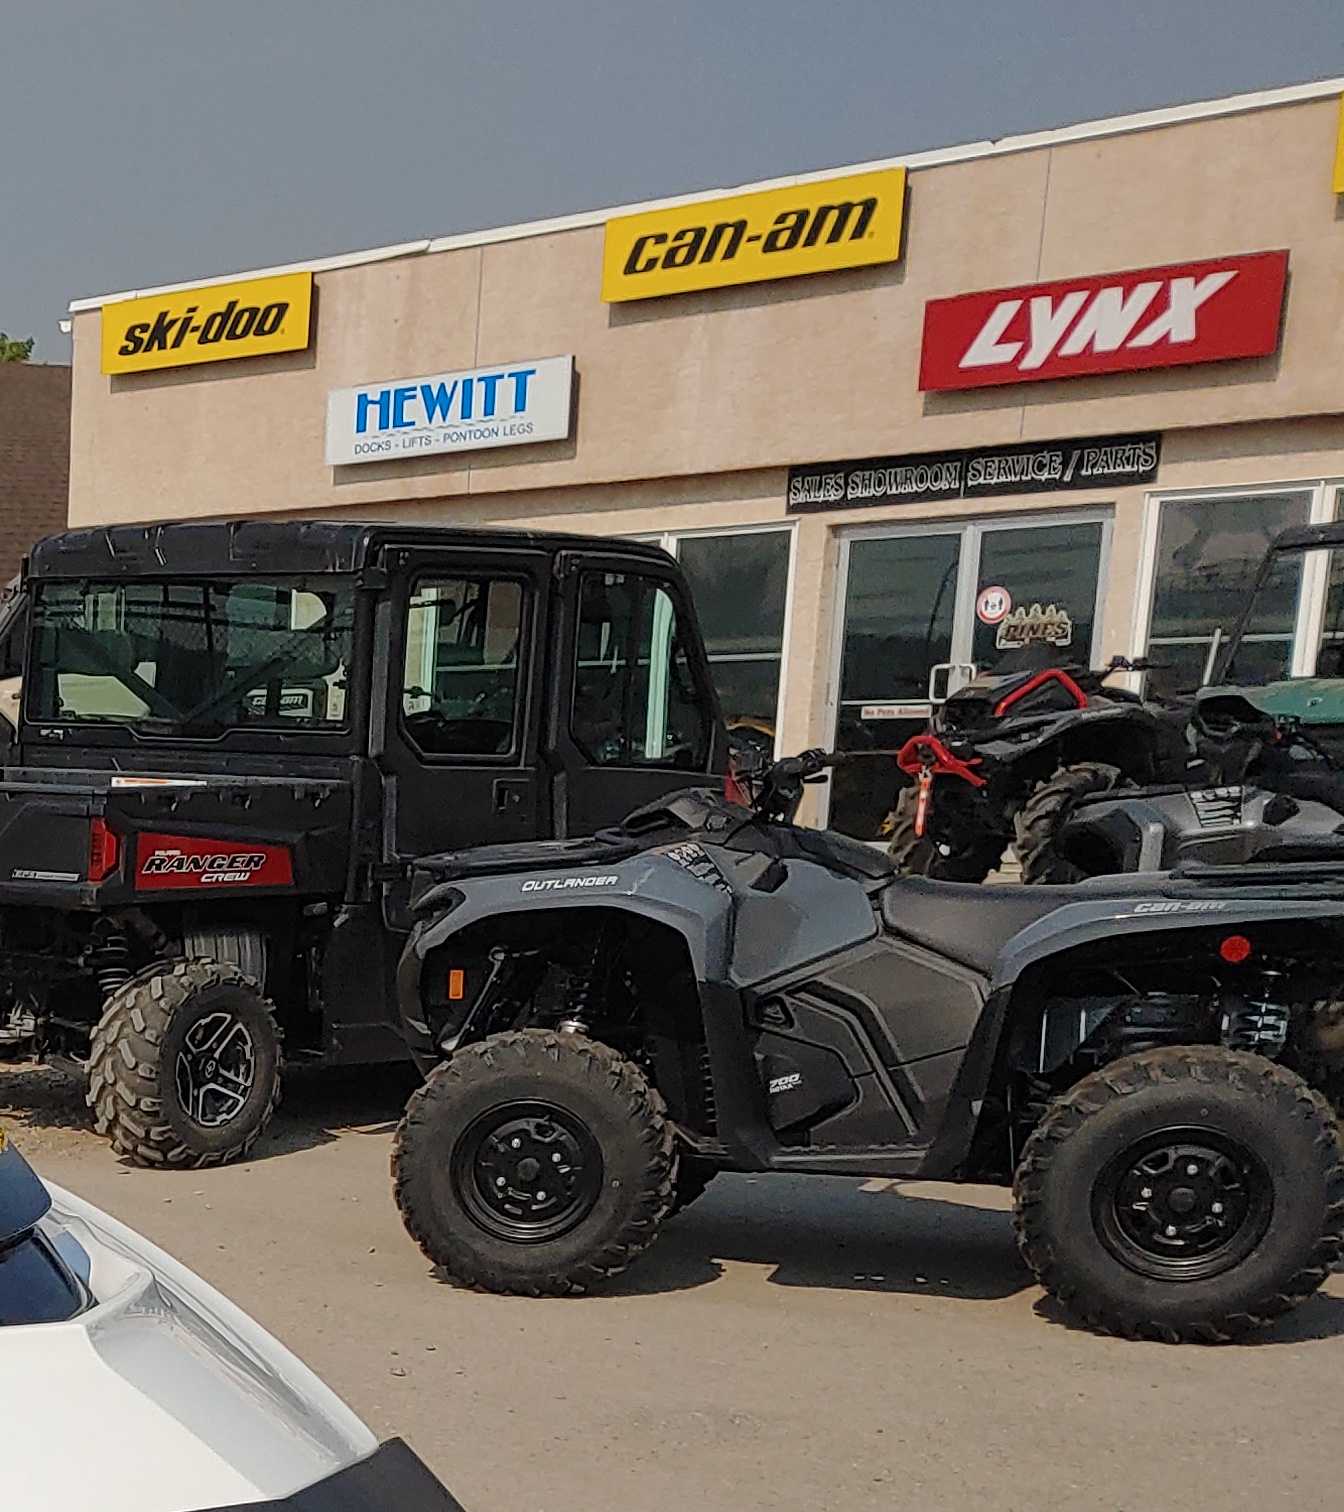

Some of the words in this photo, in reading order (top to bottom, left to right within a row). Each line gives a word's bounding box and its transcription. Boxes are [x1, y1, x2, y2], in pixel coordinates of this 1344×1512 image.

[622, 195, 878, 276] can-am
[118, 300, 289, 357] ski-doo
[958, 270, 1240, 371] LYNX
[355, 369, 537, 434] HEWITT
[354, 438, 391, 455] DOCKS
[402, 434, 432, 449] LIFTS
[443, 426, 499, 444] PONTOON
[503, 422, 534, 437] LEGS
[789, 473, 845, 505] SALES
[846, 460, 962, 500] SHOWROOM
[967, 450, 1062, 487] SERVICE
[1081, 442, 1157, 477] PARTS
[142, 853, 266, 875] RANGER
[200, 872, 250, 883] CREW
[521, 875, 620, 892] OUTLANDER
[769, 1072, 801, 1089] 700
